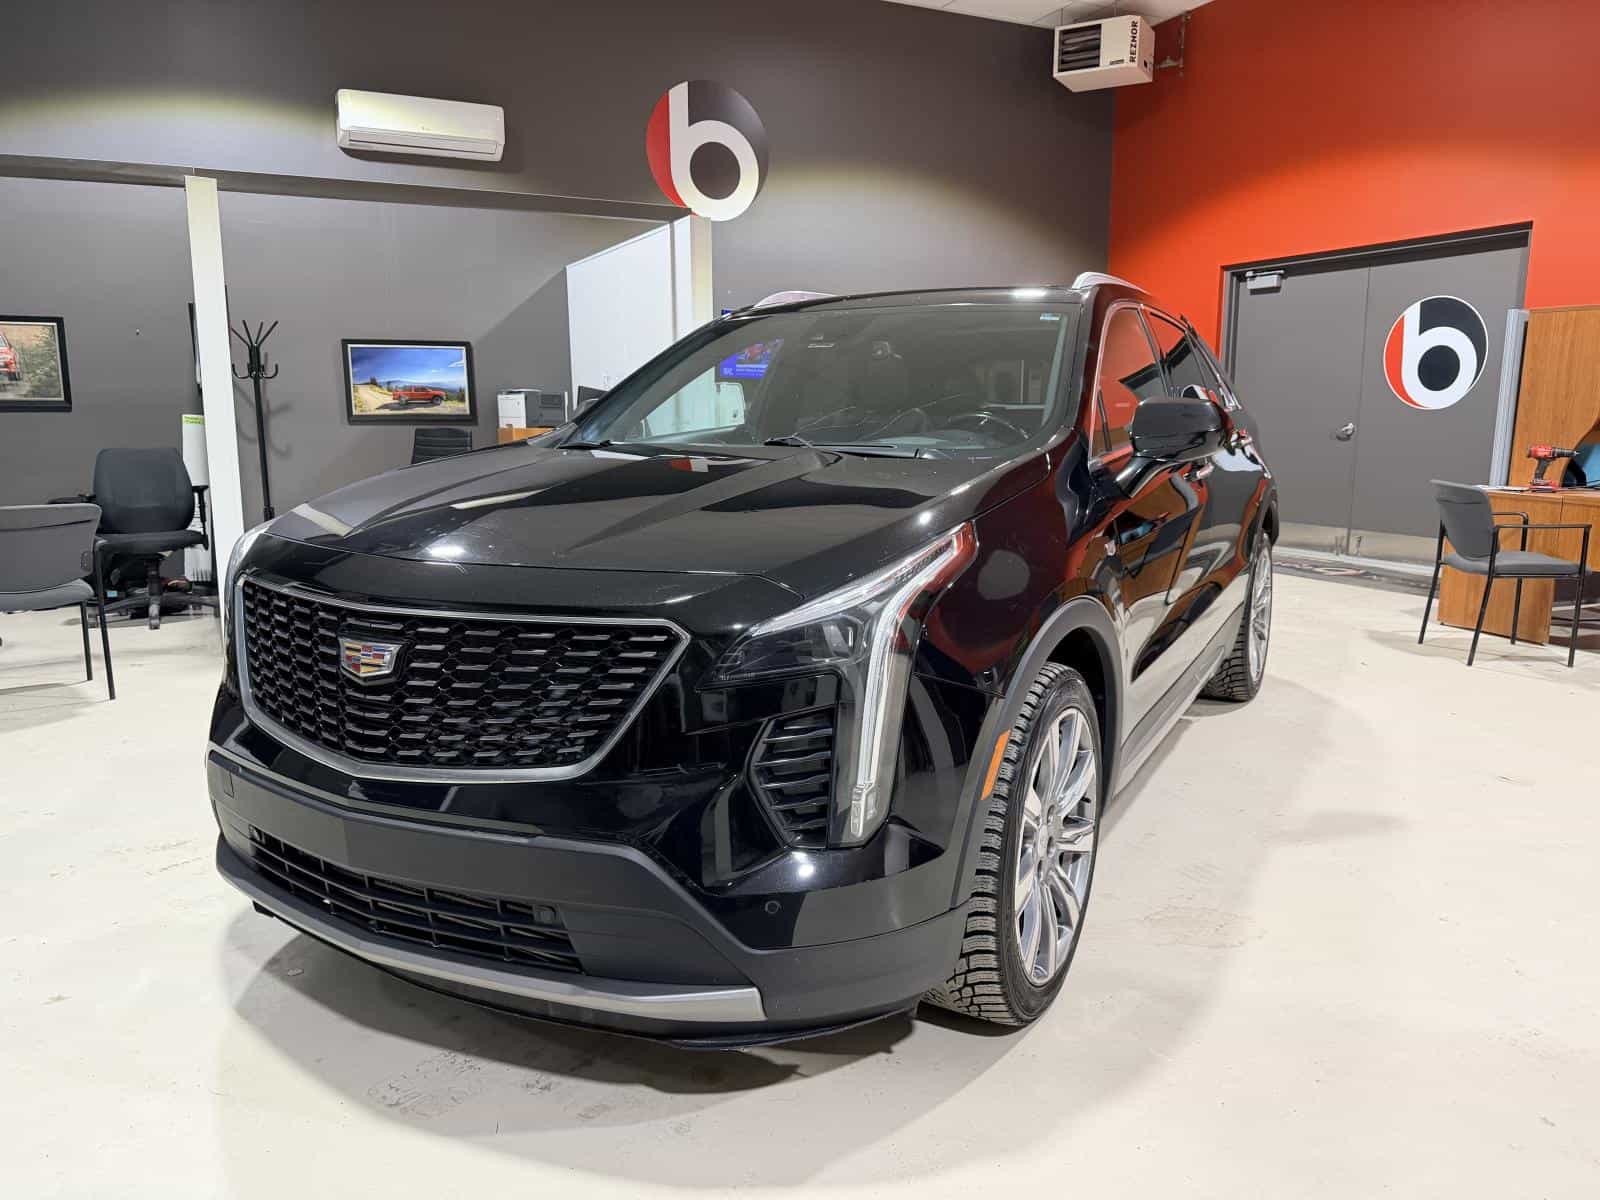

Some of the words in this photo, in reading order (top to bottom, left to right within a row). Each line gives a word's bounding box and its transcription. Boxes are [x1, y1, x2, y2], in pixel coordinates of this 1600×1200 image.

[1128, 20, 1138, 63] REZNOR
[668, 81, 760, 221] b
[1401, 301, 1478, 409] b
